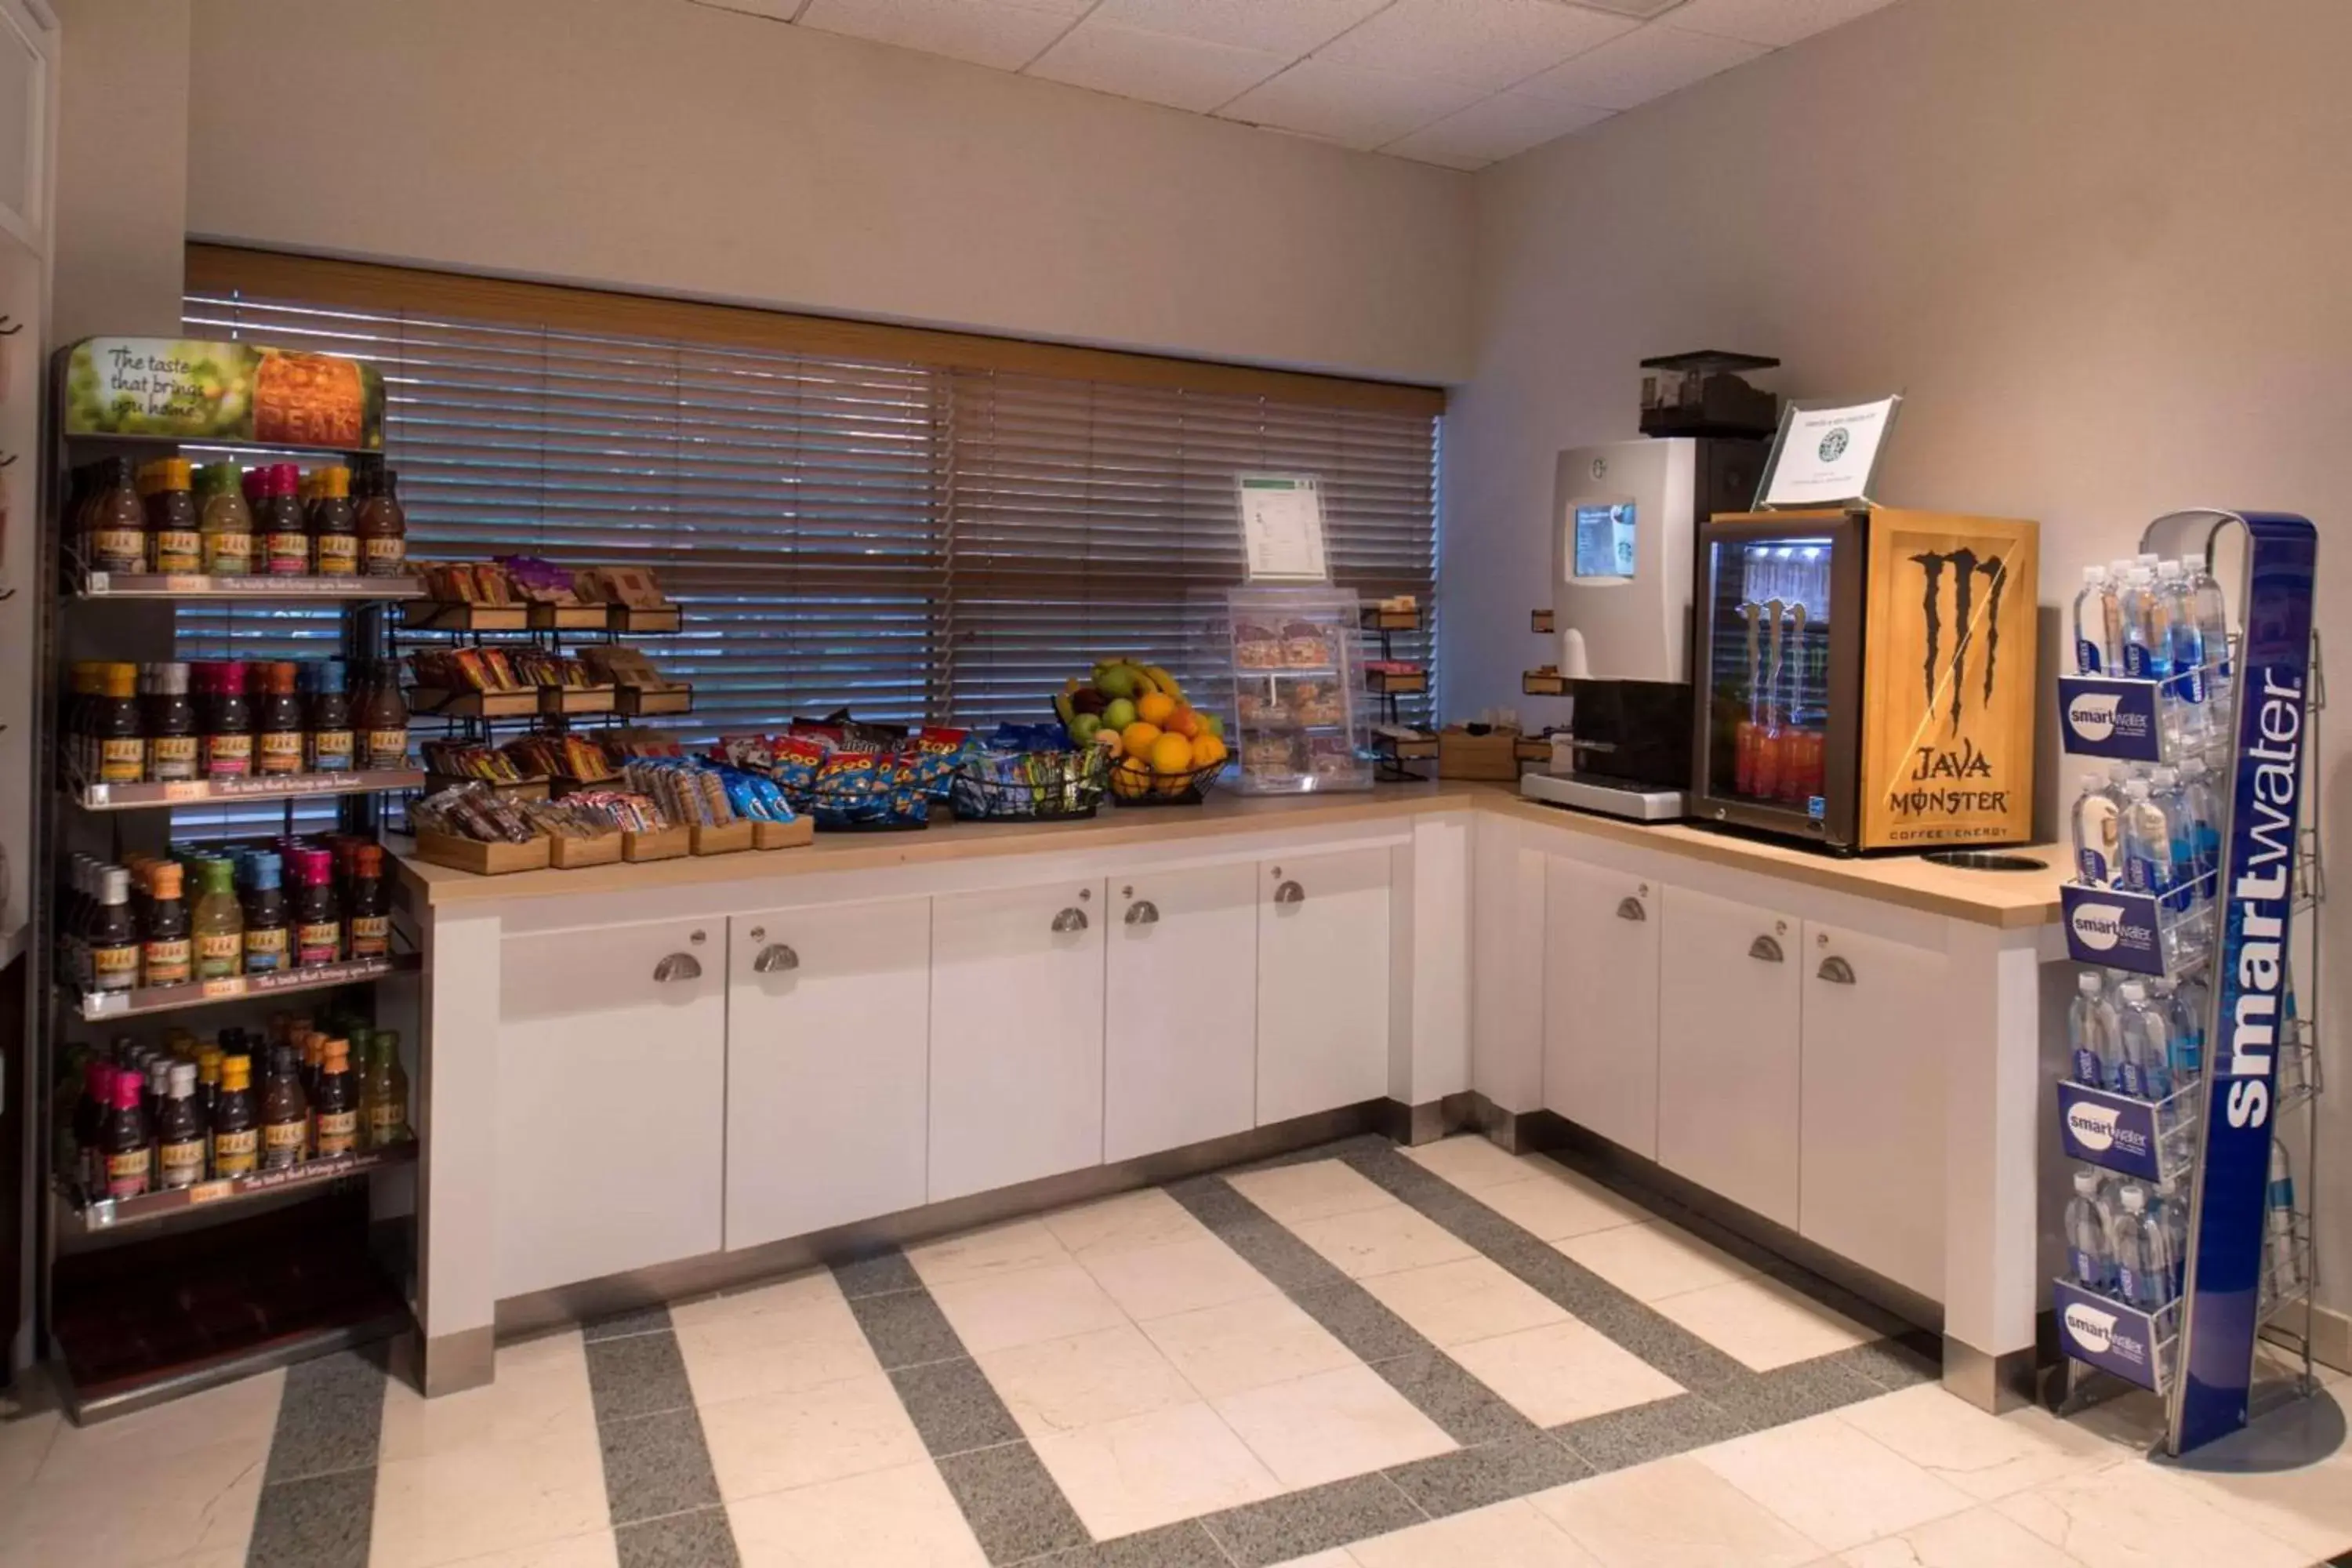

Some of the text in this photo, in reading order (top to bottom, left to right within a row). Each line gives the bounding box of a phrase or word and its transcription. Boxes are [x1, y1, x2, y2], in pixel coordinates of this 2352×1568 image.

[108, 345, 193, 374] The taste
[111, 367, 204, 405] that brings
[261, 406, 357, 441] PEAK
[2071, 709, 2148, 728] smartwater
[775, 750, 819, 767] ZOO
[1911, 737, 1992, 782] JAVA
[1889, 787, 2008, 817] MONSTER
[2227, 667, 2301, 1129] smartwater
